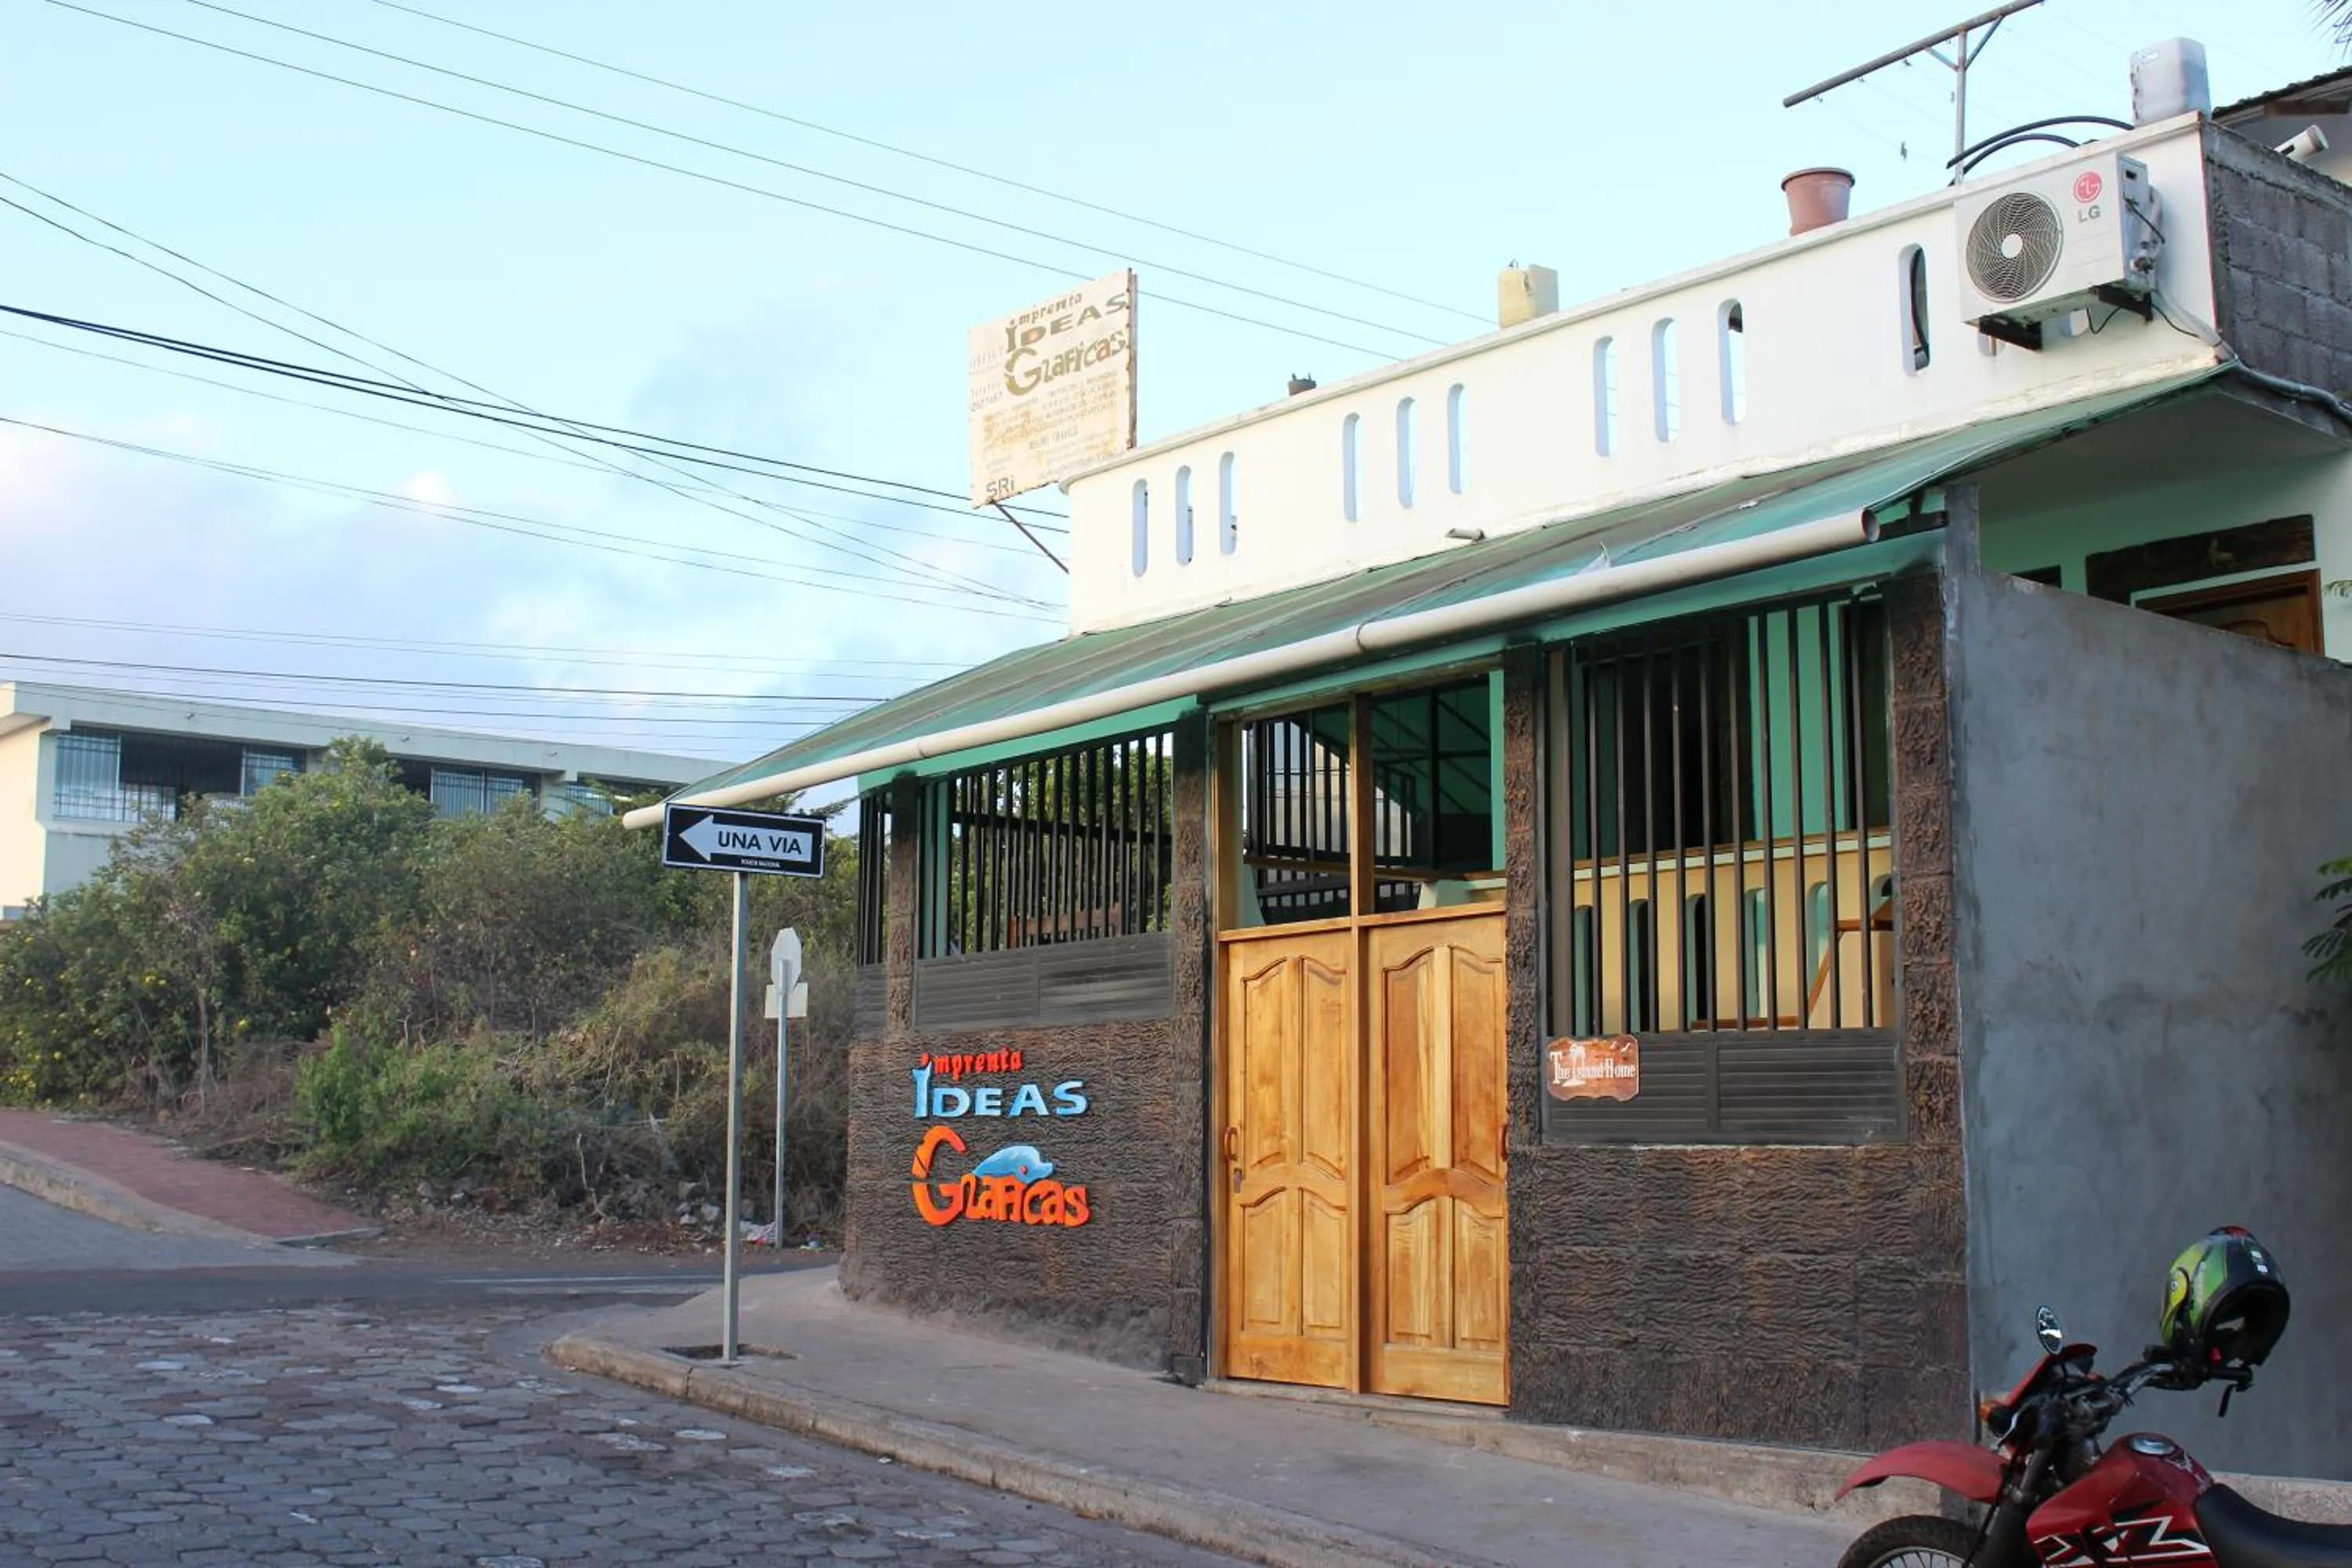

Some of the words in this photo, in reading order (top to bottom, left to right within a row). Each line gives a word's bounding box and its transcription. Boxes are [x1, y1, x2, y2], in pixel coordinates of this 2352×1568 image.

[2078, 205, 2100, 223] LG
[1005, 293, 1127, 353] IDEAS
[717, 830, 761, 851] UNA
[768, 835, 802, 855] VIA
[1550, 1051, 1570, 1084] The
[1605, 1057, 1636, 1079] Home
[912, 1061, 1088, 1118] IDEAS
